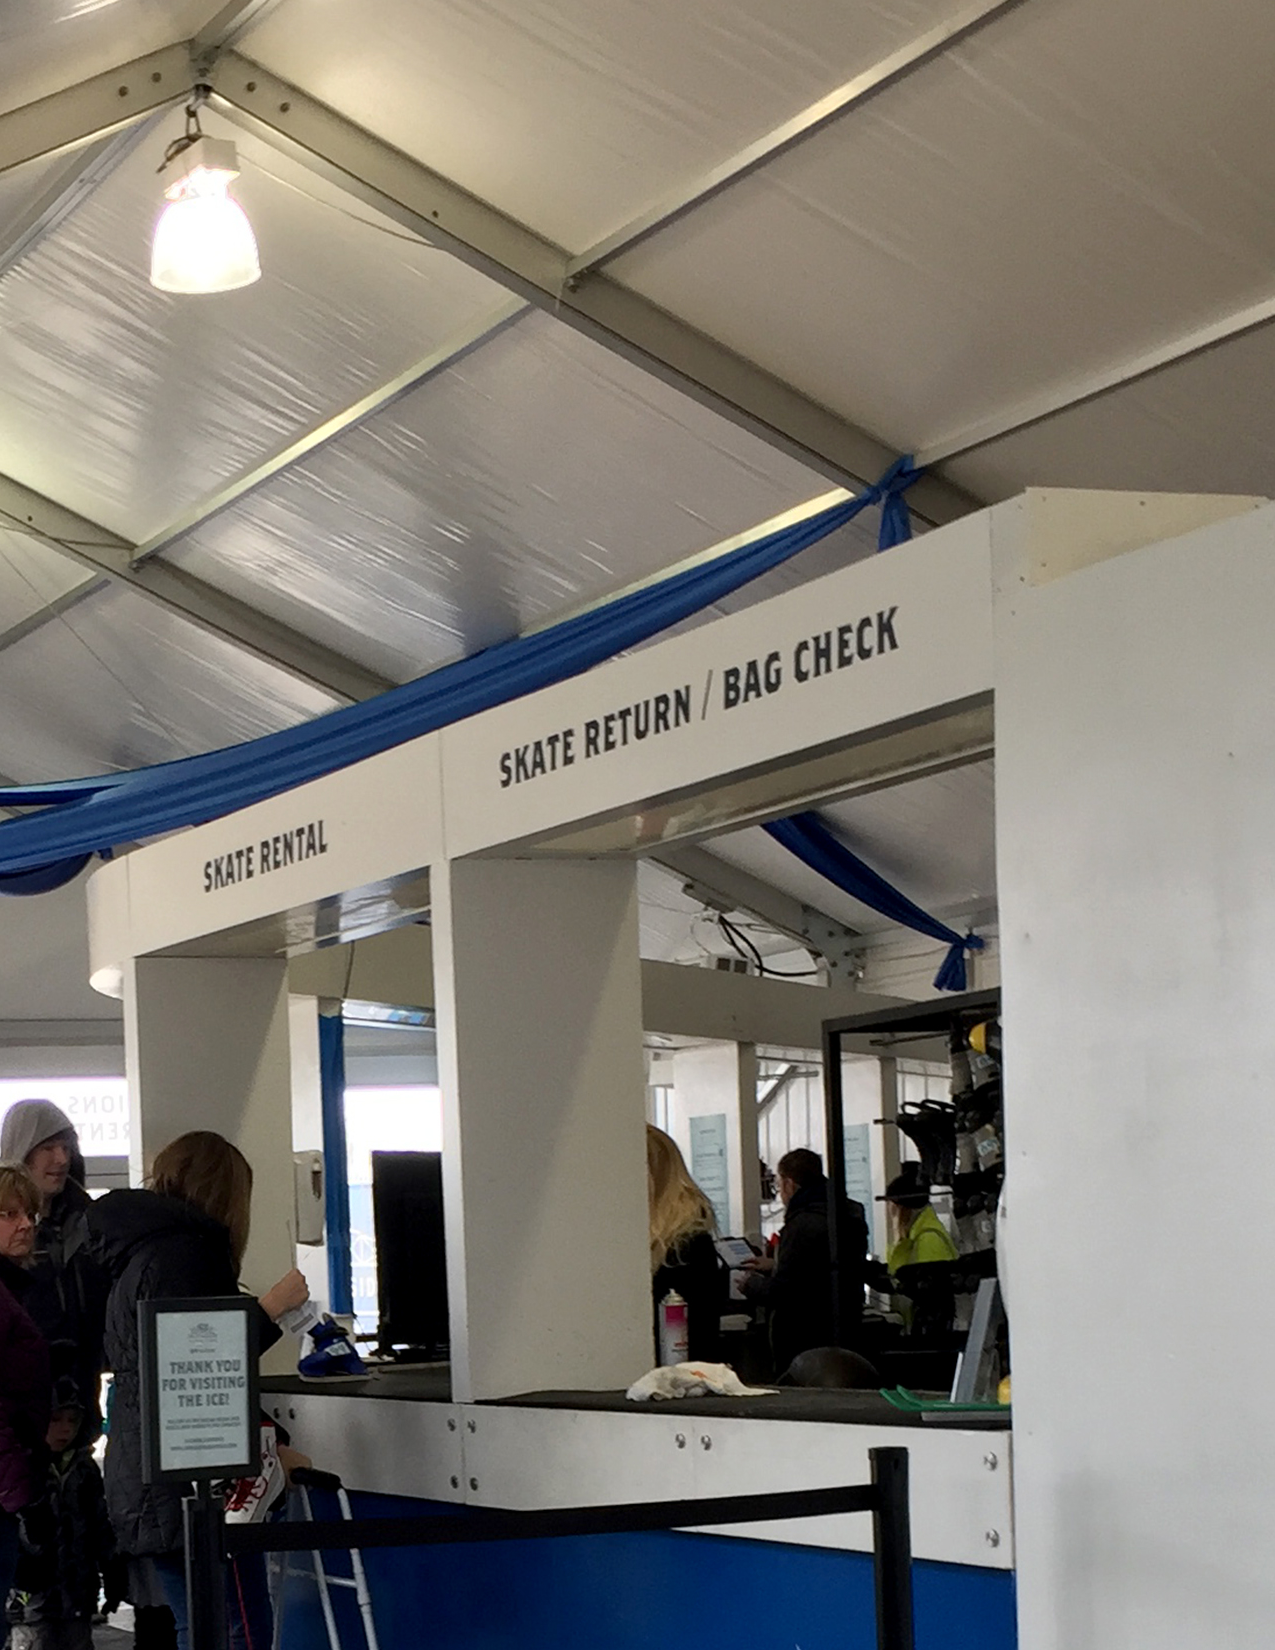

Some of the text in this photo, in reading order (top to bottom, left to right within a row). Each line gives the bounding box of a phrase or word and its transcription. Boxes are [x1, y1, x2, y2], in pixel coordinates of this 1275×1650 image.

[499, 605, 899, 788] SKATE RETURN / BAG CHECK
[204, 819, 328, 893] SKATE RENTAL
[169, 1359, 241, 1374] THANK YOU
[162, 1376, 245, 1391] FOR VISITING
[177, 1393, 229, 1407] THE ICE!
